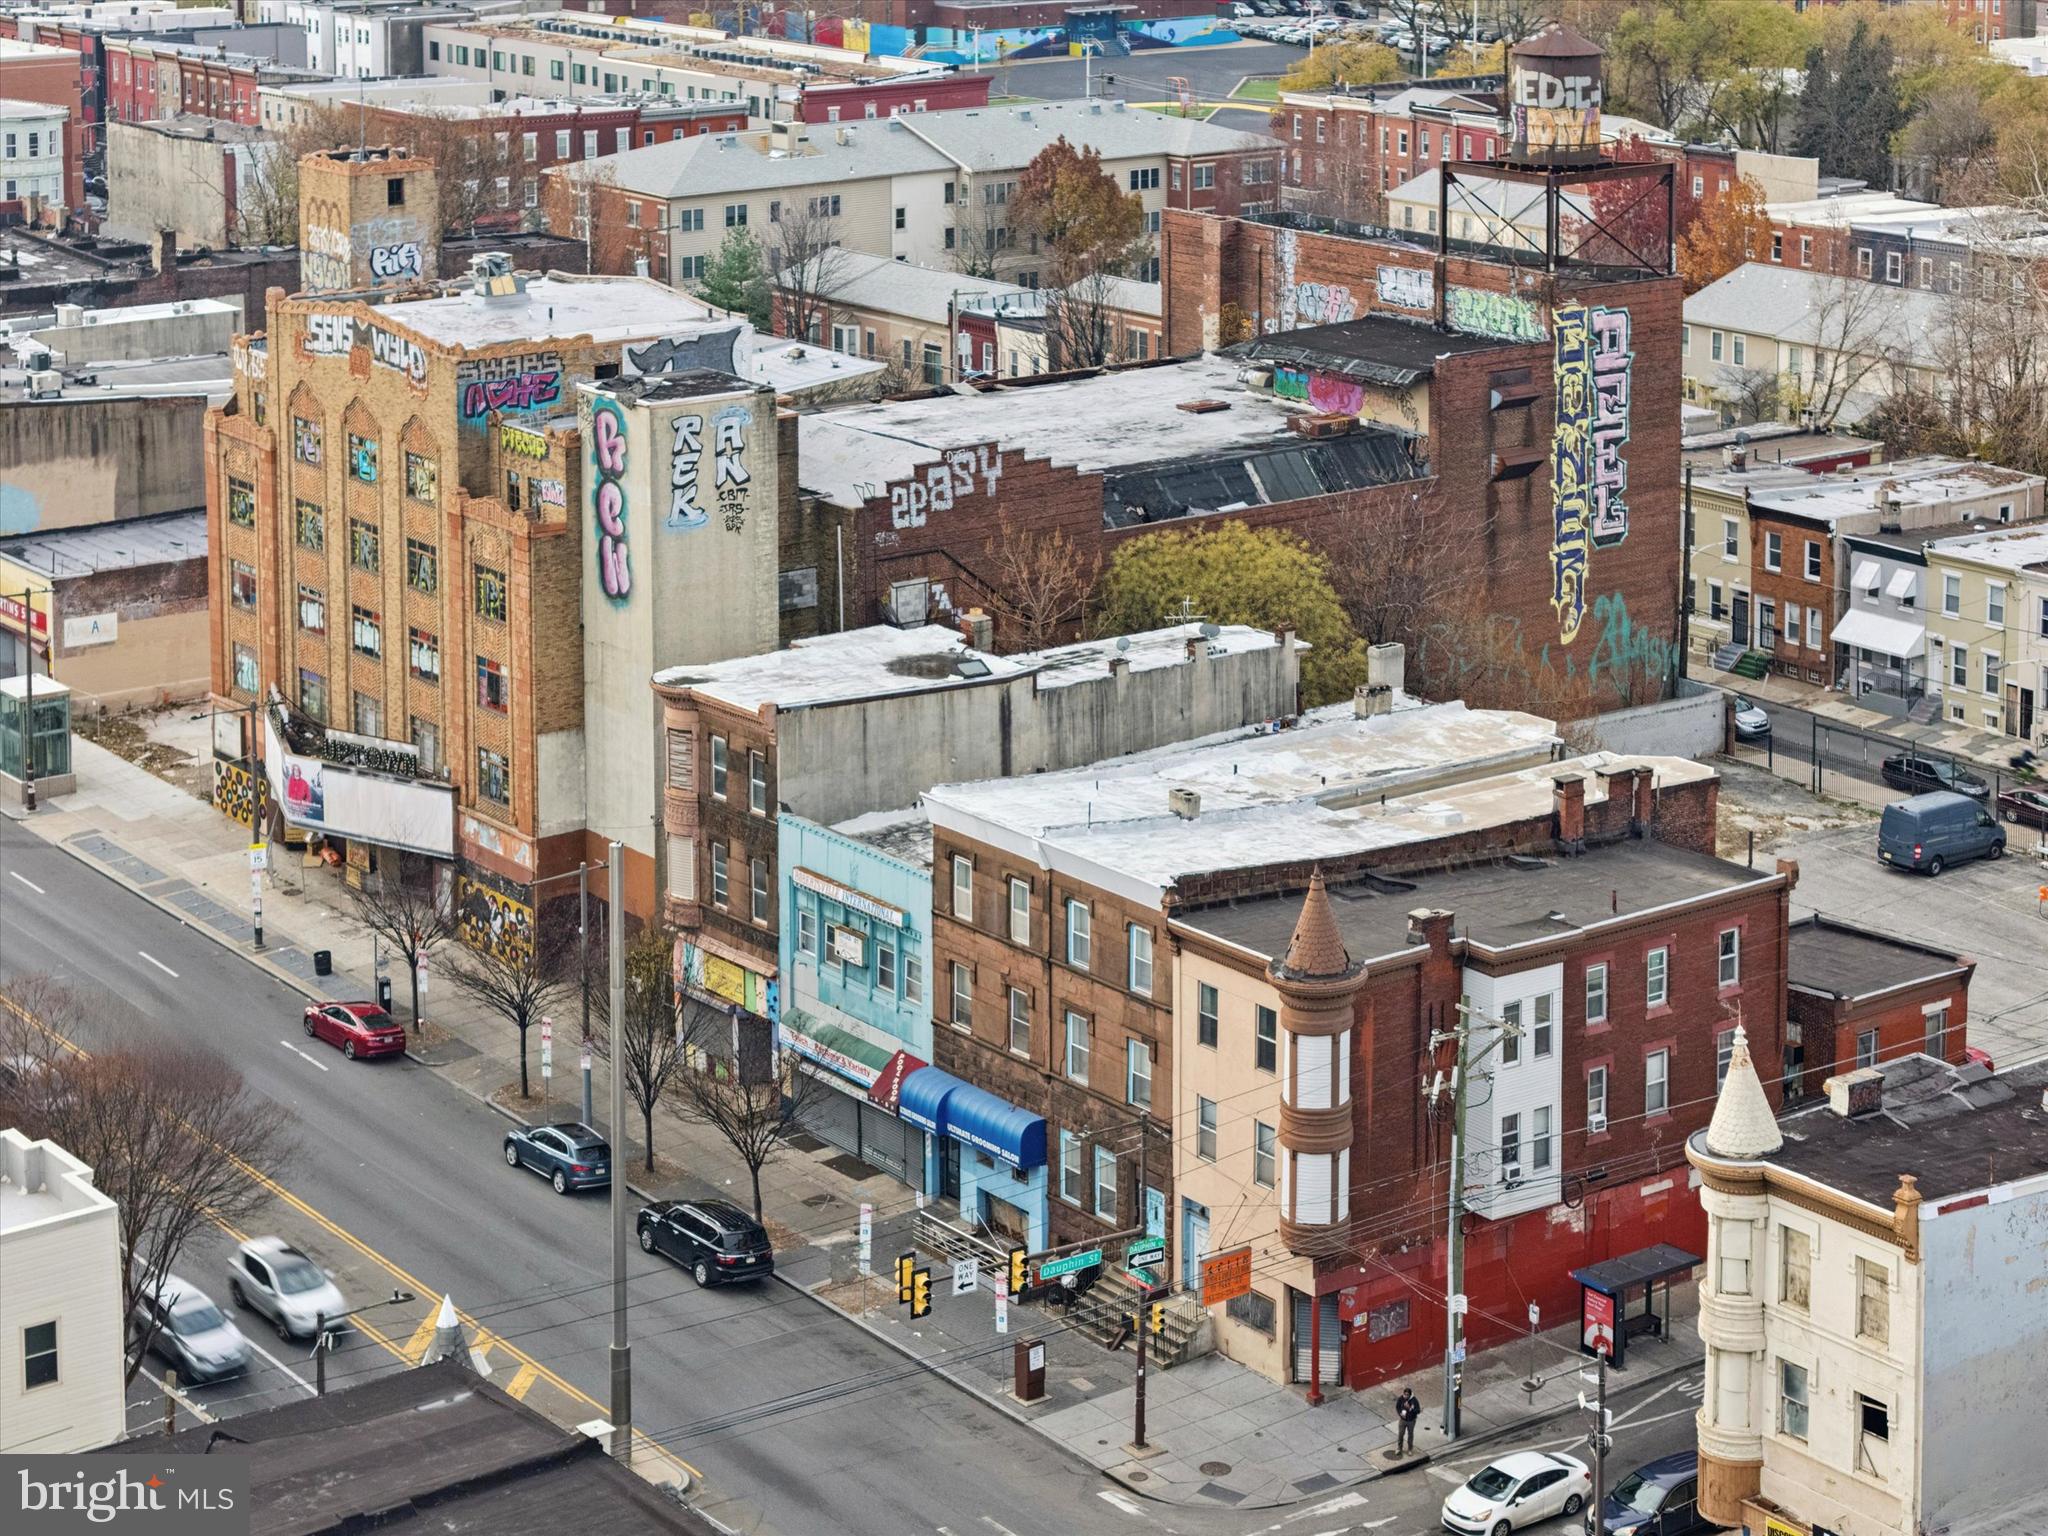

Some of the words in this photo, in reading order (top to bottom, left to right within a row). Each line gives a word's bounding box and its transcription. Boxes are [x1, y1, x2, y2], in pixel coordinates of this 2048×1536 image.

[323, 738, 417, 778] UPTOWN
[958, 1261, 974, 1272] ONE
[1043, 1259, 1084, 1277] Dauphin
[957, 1270, 974, 1281] WAY
